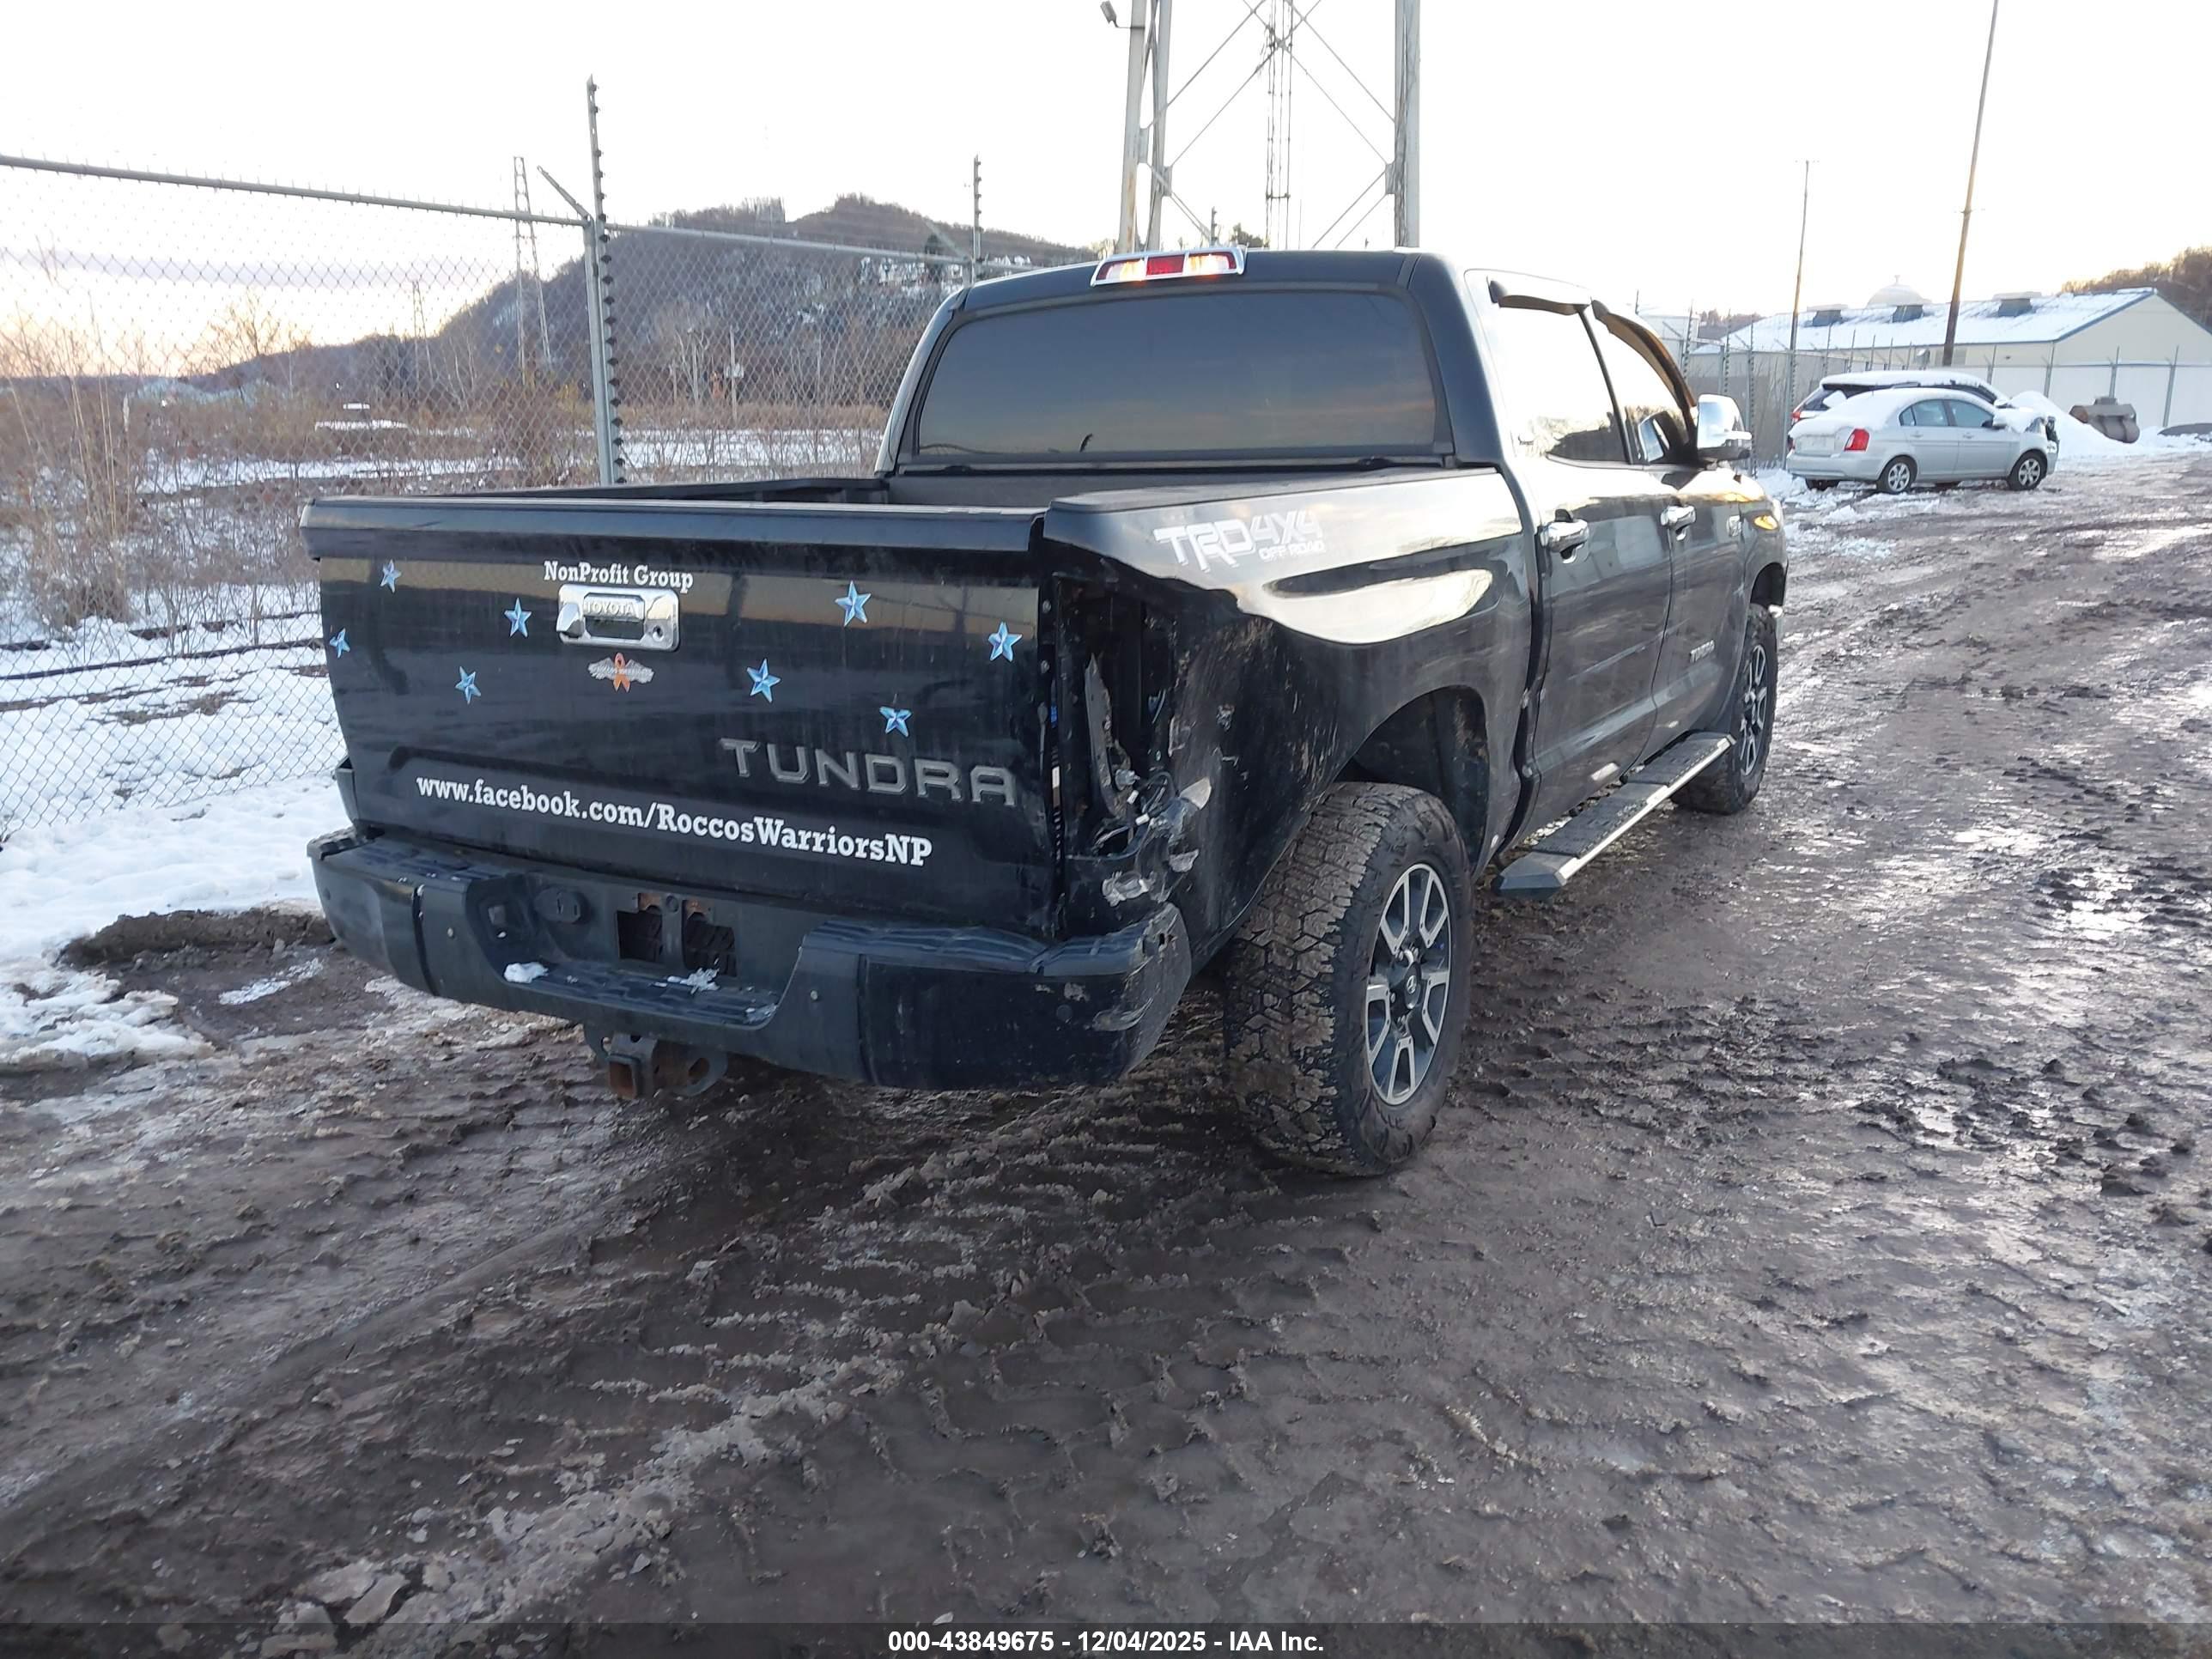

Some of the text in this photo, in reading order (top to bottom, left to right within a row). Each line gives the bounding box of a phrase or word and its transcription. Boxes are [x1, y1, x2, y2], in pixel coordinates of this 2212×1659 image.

[1153, 519, 1256, 573] TRD
[1258, 540, 1327, 562] OFF ROAD
[544, 561, 694, 594] NonProfit Group
[585, 601, 636, 616] TOYOTA
[720, 738, 1017, 807] TUNDRA
[416, 777, 933, 866] www.facebook.com/RoccosWarriorsNP
